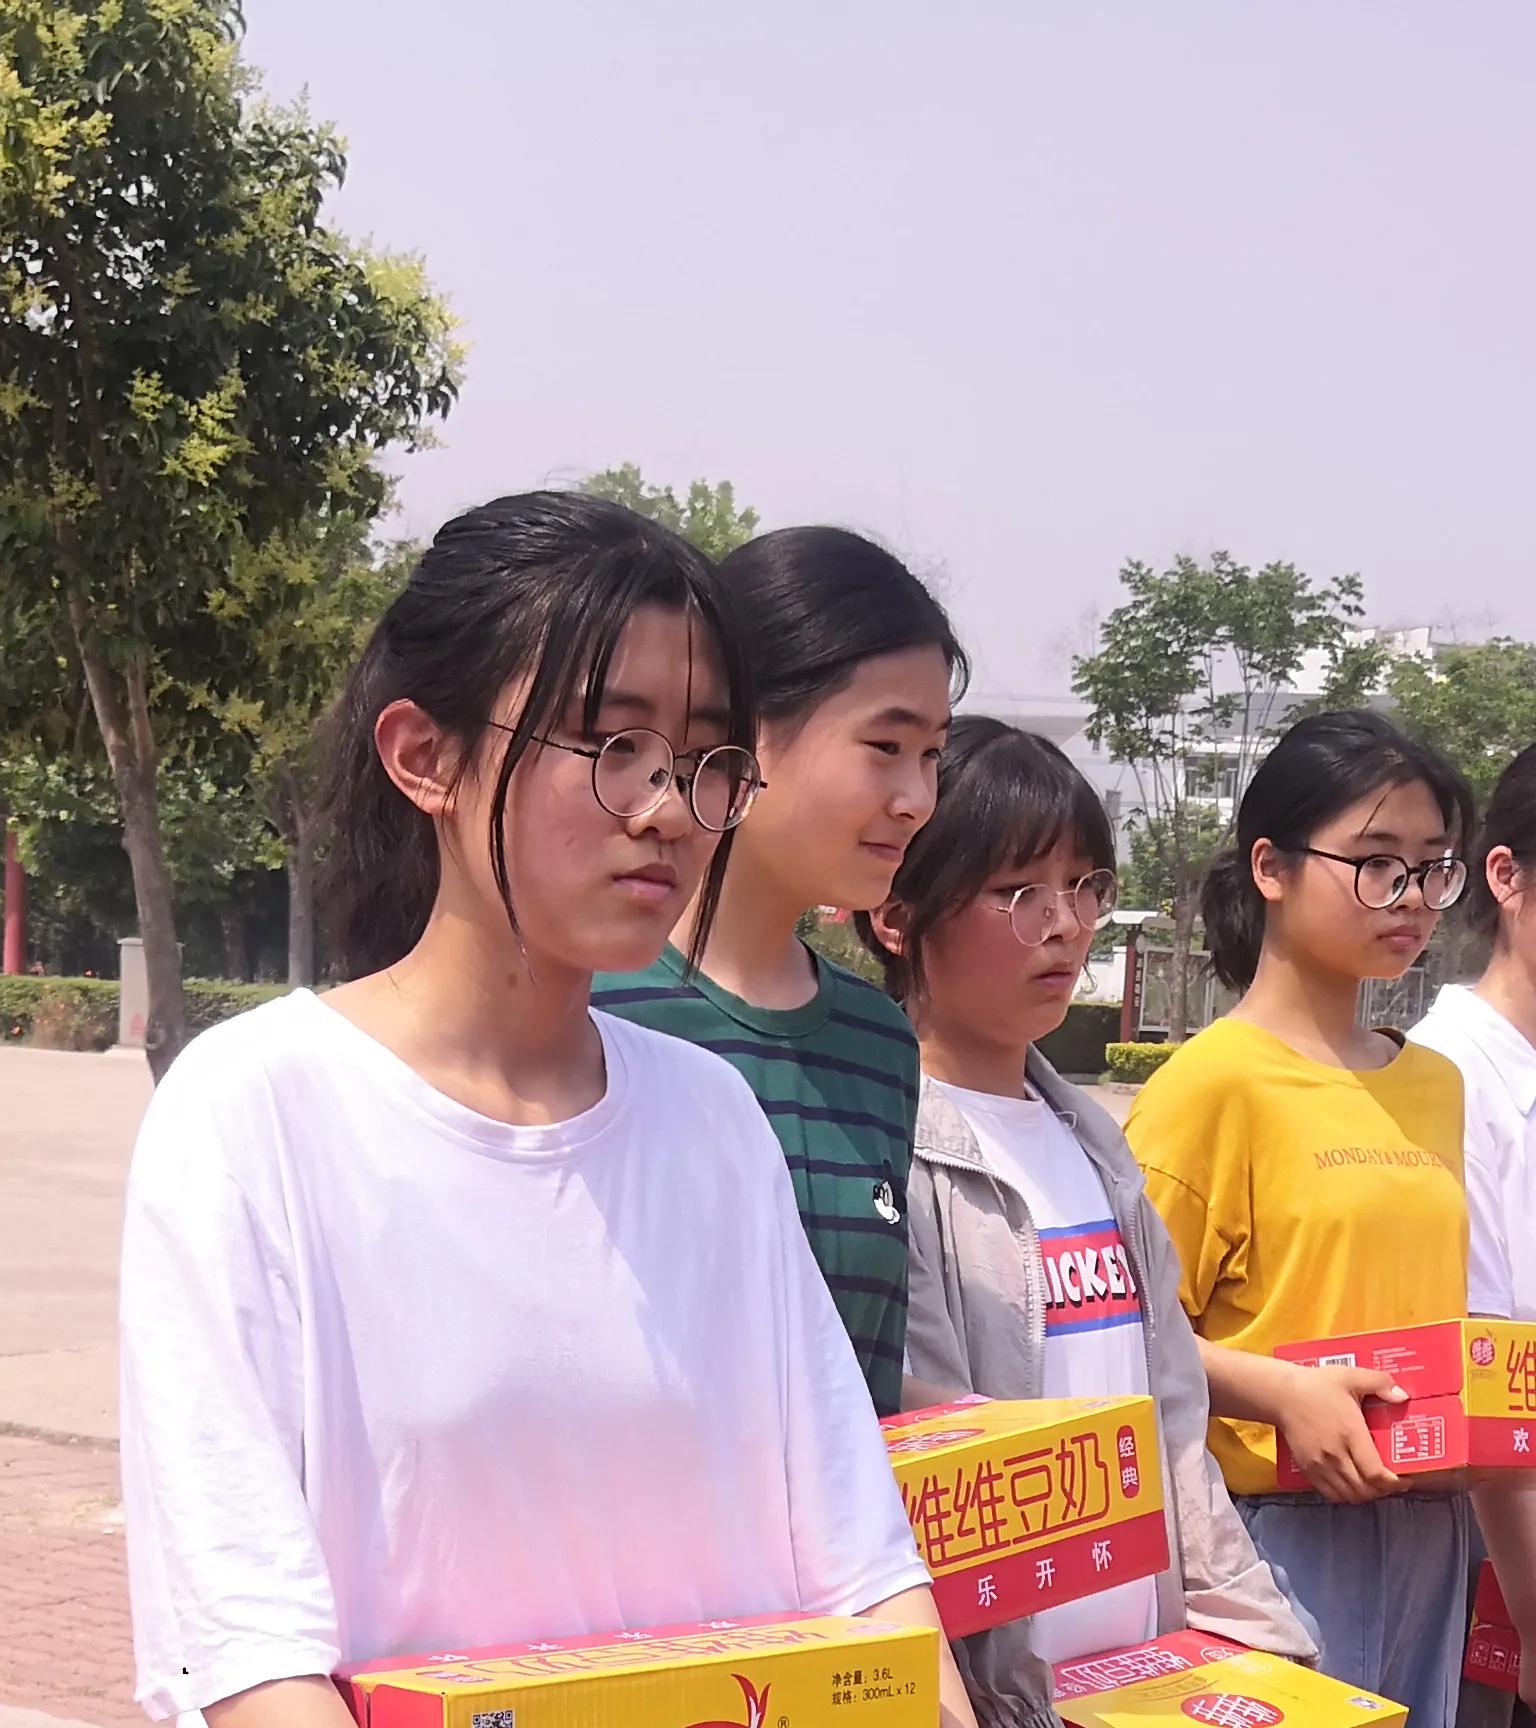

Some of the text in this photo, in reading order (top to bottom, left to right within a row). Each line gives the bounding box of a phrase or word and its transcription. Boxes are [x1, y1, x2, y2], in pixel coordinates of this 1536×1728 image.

[1119, 1435, 1139, 1489] 经典
[902, 1432, 1111, 1569] 维维豆奶
[977, 1539, 1113, 1608] 乐开怀
[872, 1667, 894, 1683] 3.6L
[905, 1682, 917, 1697] 12
